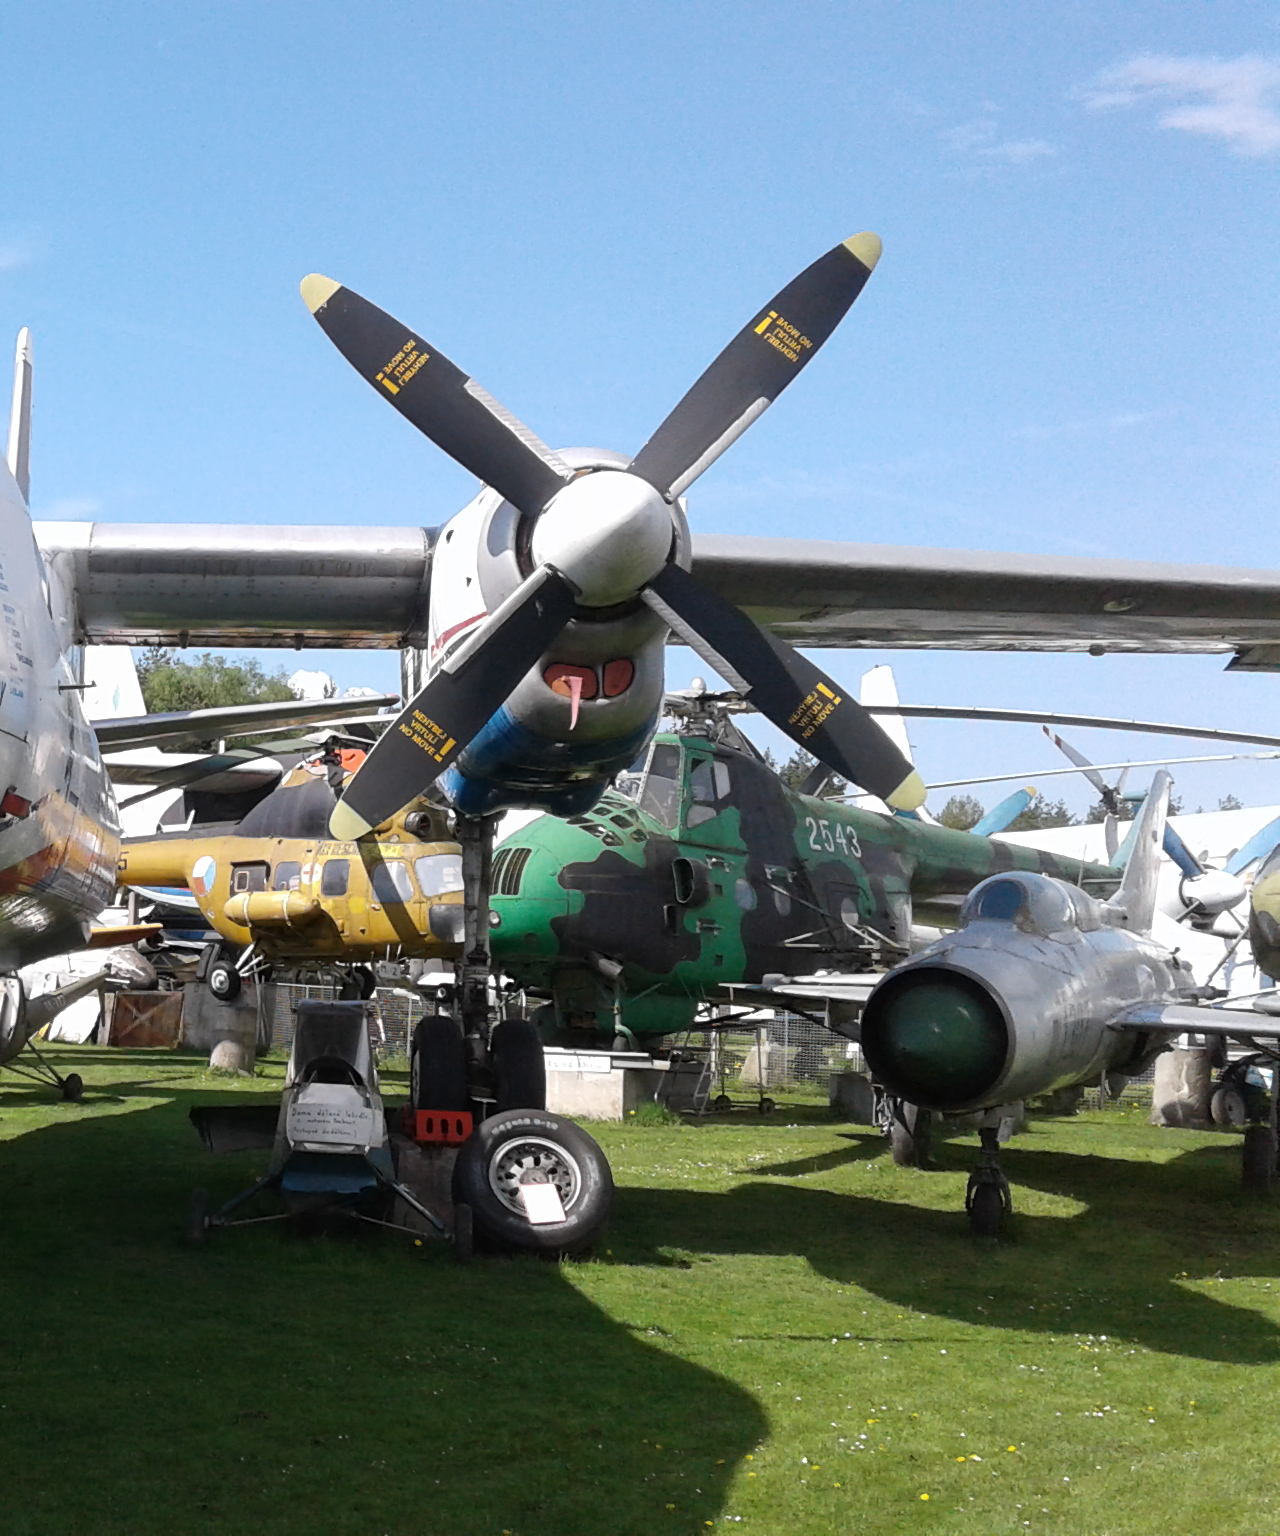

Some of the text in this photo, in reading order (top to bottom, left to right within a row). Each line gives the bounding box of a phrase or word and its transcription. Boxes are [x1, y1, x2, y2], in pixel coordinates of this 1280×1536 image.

[775, 317, 800, 338] MOVE
[402, 339, 416, 352] NO
[798, 335, 812, 348] NO
[382, 351, 405, 373] MOVE
[800, 725, 815, 739] NO
[812, 702, 834, 725] MOVE
[398, 723, 412, 736] NO
[411, 733, 435, 755] MOVE
[805, 817, 862, 858] 2543
